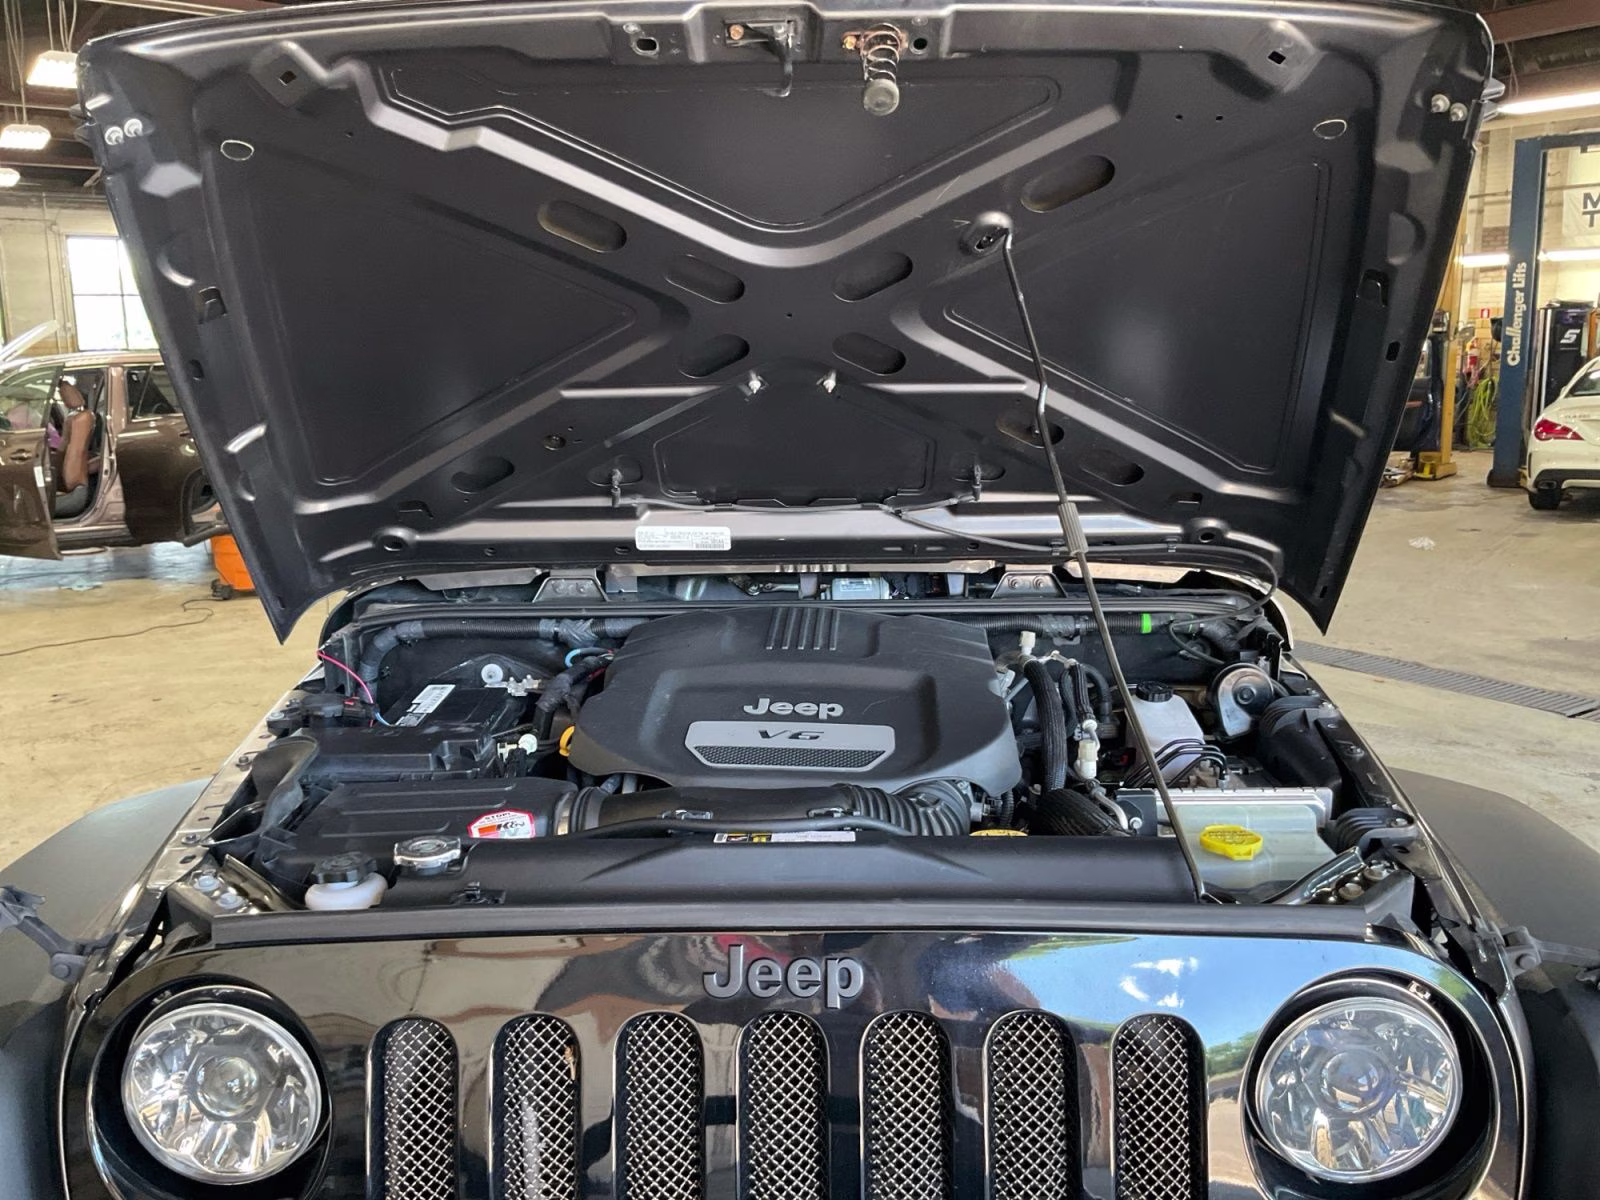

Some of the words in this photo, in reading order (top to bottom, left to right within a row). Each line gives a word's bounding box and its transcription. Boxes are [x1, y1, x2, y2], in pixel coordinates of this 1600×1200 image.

[1512, 262, 1527, 288] Lifts
[1505, 290, 1527, 366] Challenger
[743, 698, 844, 720] Jeep
[758, 729, 825, 741] V6
[703, 944, 864, 1009] Jeep
